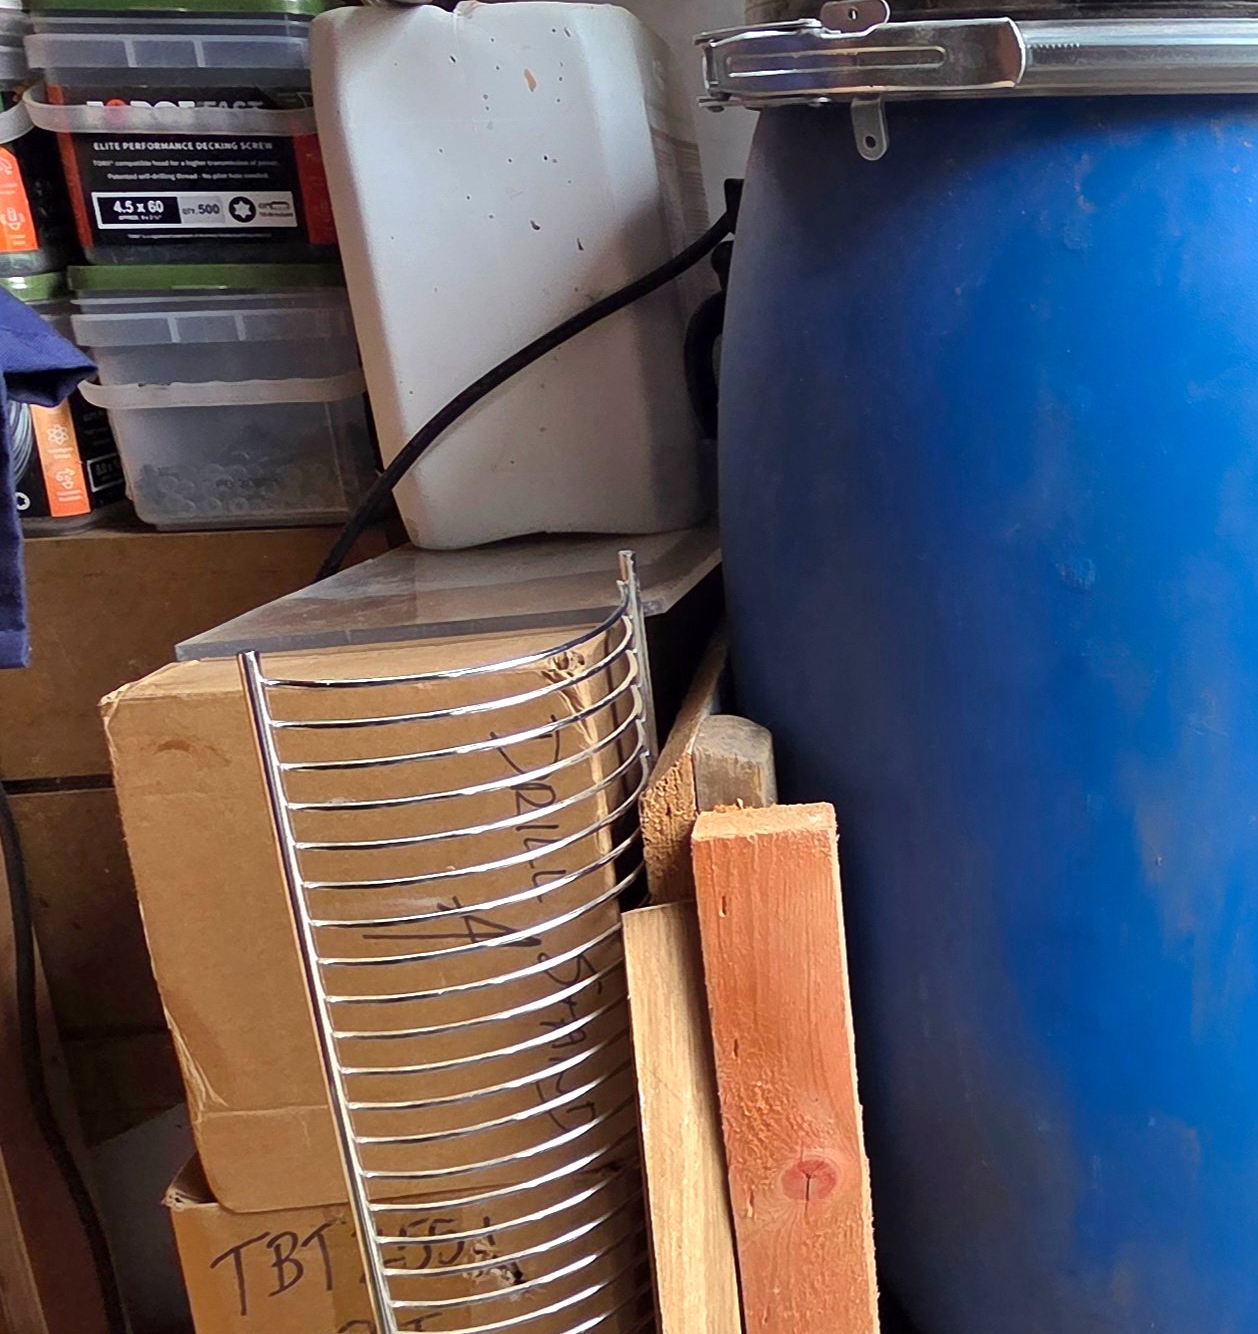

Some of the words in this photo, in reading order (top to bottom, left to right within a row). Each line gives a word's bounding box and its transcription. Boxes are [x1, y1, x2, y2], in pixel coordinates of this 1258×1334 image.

[93, 142, 120, 150] ELITE
[122, 142, 194, 150] PERFORMANCE
[195, 142, 238, 150] DECKING
[240, 142, 273, 150] SCREW
[113, 200, 134, 214] 4.5
[136, 203, 146, 213] x
[147, 200, 165, 213] 60
[197, 203, 220, 214] 500
[210, 1219, 336, 1316] TBT
